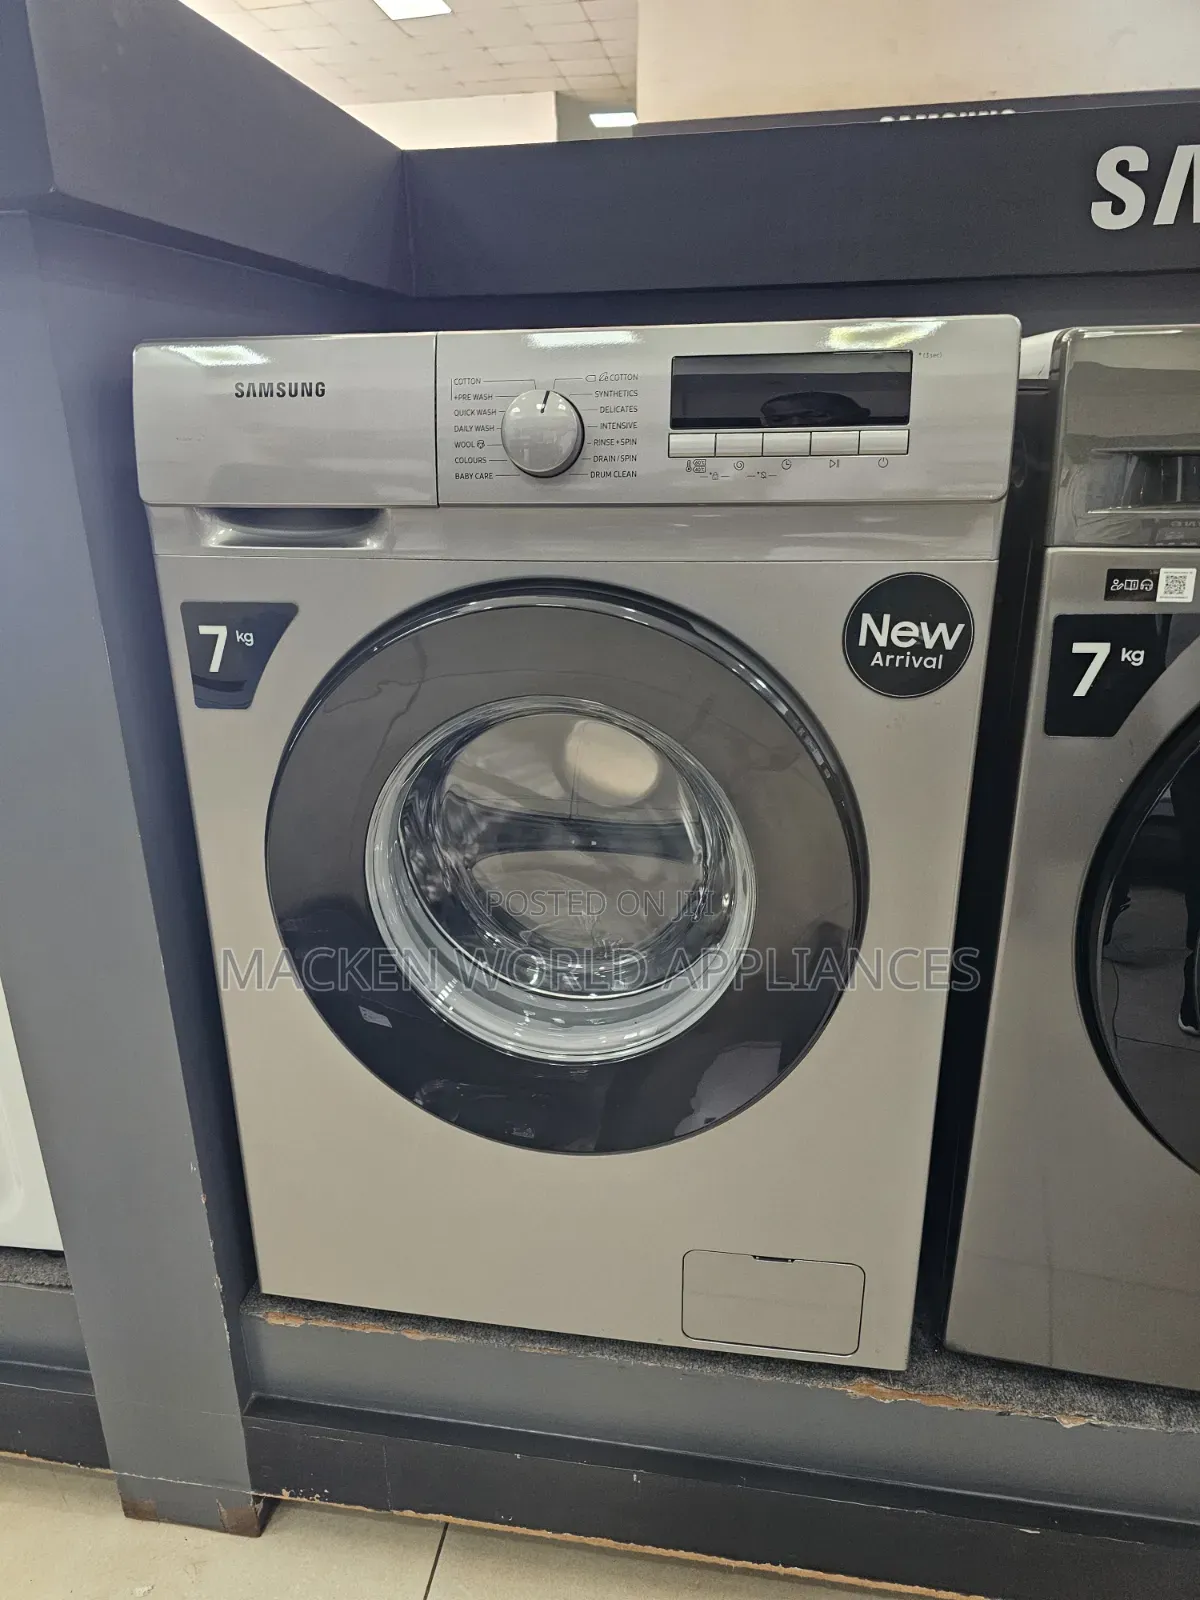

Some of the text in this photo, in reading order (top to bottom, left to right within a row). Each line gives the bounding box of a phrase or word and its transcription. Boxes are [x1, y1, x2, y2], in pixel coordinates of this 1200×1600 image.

[453, 377, 482, 386] COTTON
[609, 373, 639, 382] COTTON
[234, 381, 326, 399] SAMSUNG
[594, 389, 639, 398] SYNTHETICS
[473, 393, 493, 401] WASH
[453, 408, 497, 417] QUICK WASH
[599, 405, 639, 414] DELICATES
[475, 424, 495, 432] WASH
[600, 421, 638, 430] INTENSIVE
[593, 438, 615, 446] RINSE
[620, 438, 637, 446] SPIN
[454, 456, 487, 464] COLOURS
[593, 455, 616, 463] DRAIN
[620, 454, 637, 462] SPIN
[474, 472, 494, 480] CARE
[590, 470, 637, 479] DRUM CLEAN
[858, 612, 966, 651] New
[198, 625, 254, 673] 7 kg
[870, 651, 943, 670] Arrival
[1071, 642, 1145, 697] 7 kg
